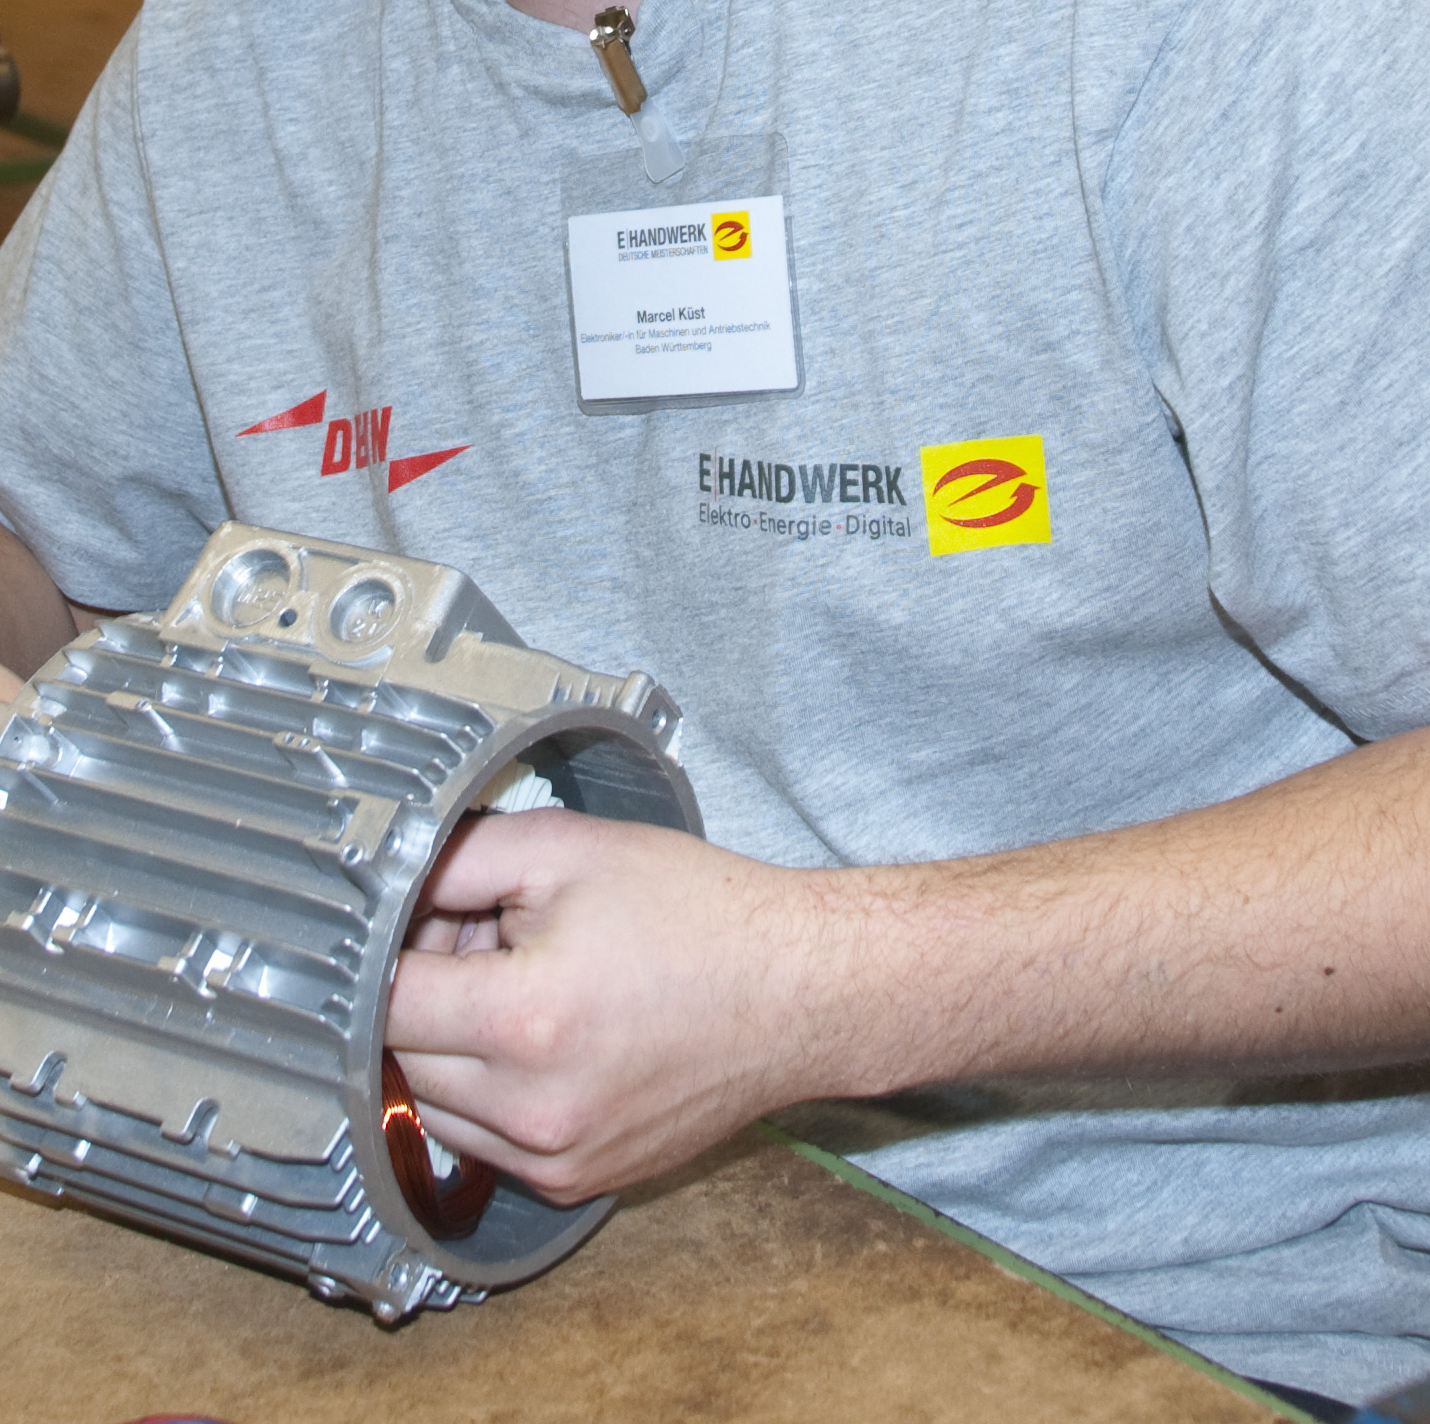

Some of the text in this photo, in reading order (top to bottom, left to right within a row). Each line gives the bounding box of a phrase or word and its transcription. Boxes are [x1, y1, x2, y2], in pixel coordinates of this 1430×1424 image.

[618, 245, 709, 262] DEUTSCHE MEISTERSCHAFTEN
[636, 306, 706, 324] Marcel Küst
[636, 329, 647, 340] für
[648, 327, 690, 340] Maschinen
[692, 325, 707, 336] und
[708, 321, 771, 335] Antriebstechnik
[635, 340, 712, 355] Baden Württemberg
